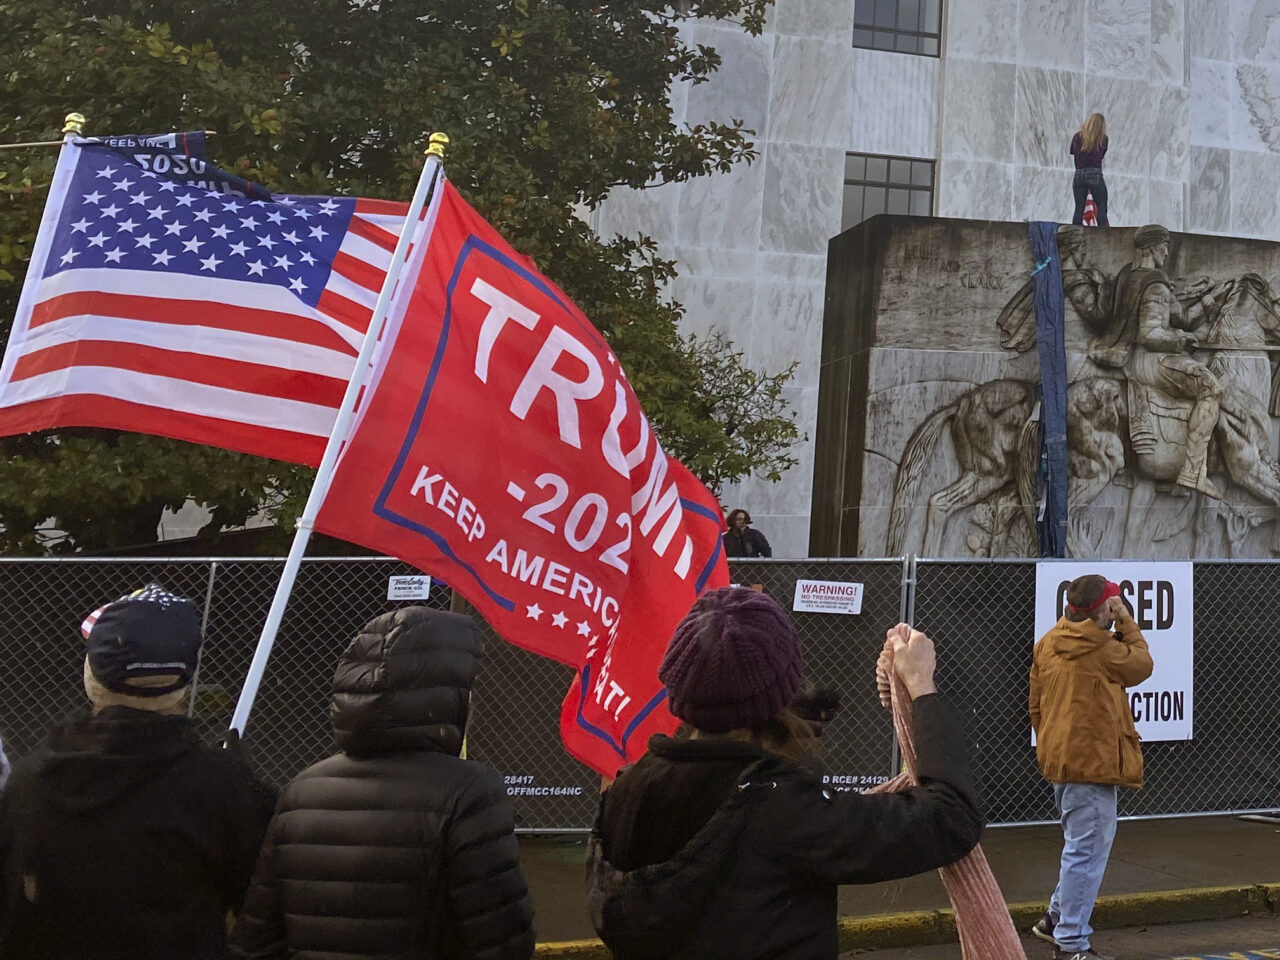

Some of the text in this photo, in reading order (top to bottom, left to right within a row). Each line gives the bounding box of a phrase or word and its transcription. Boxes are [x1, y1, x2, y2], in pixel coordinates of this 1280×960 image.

[409, 464, 487, 543] KEEP
[801, 583, 858, 597] WARNING!
[811, 594, 855, 602] TRESPASSING
[1055, 579, 1175, 631] CSED
[503, 775, 535, 785] 28417
[832, 776, 859, 784] RCE#
